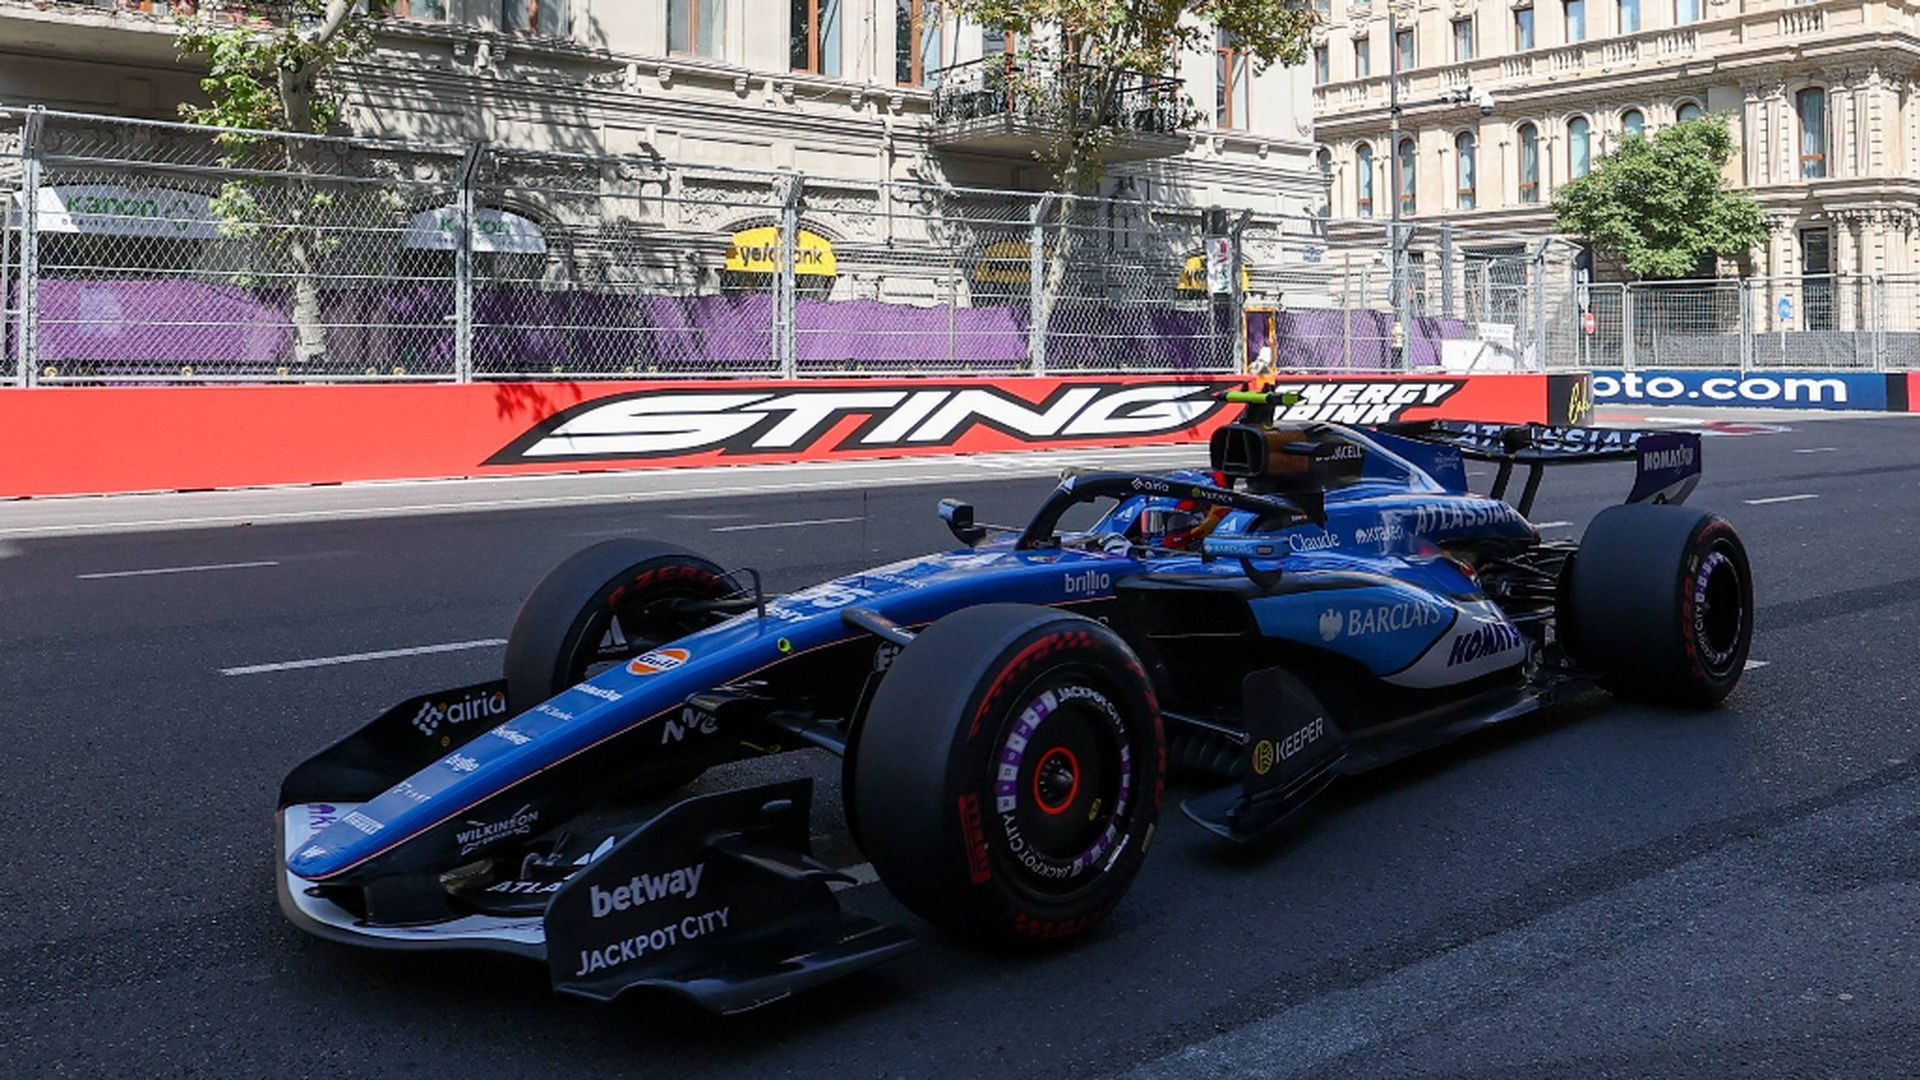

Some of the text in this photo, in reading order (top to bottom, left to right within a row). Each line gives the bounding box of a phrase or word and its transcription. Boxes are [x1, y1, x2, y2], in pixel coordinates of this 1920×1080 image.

[519, 385, 1213, 458] STING
[1273, 405, 1400, 424] RINK
[1288, 530, 1341, 552] Claude
[1064, 570, 1111, 596] brillio
[1347, 602, 1441, 637] BARCLAYS
[639, 653, 680, 668] Gulf
[446, 691, 507, 724] airia
[1275, 716, 1324, 764] KEEPER
[1001, 814, 1025, 853] CITY
[589, 863, 705, 919] betway
[575, 907, 730, 977] JACKPOT CITY
